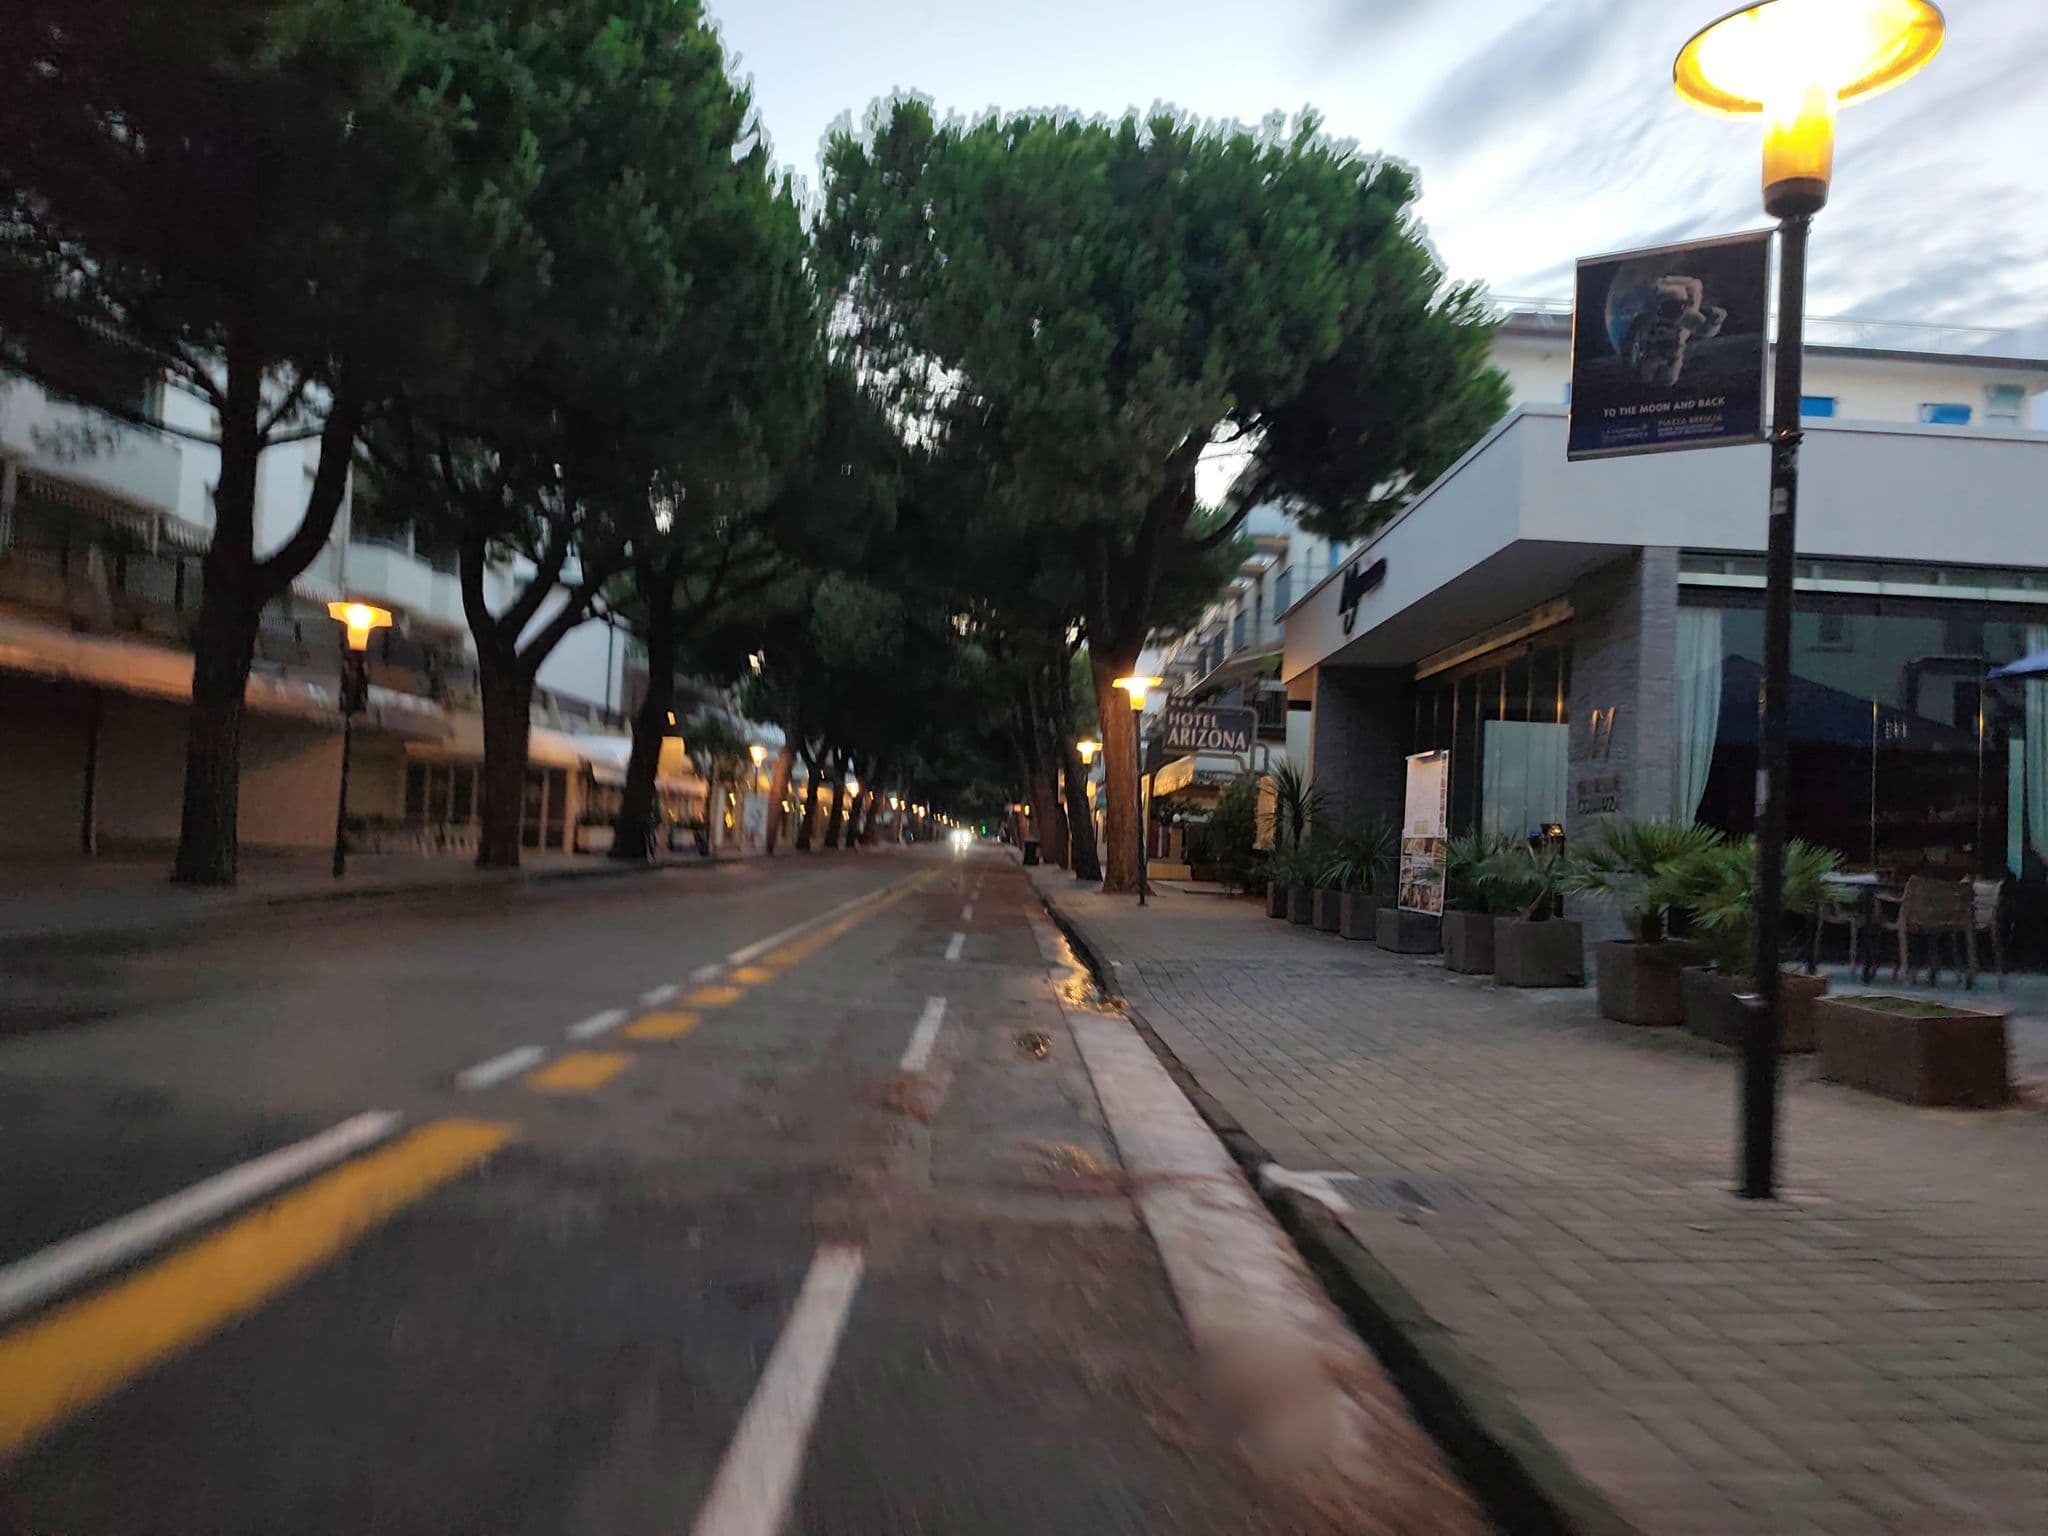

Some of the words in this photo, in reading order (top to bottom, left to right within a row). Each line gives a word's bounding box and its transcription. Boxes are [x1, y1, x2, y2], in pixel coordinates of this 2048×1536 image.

[1603, 408, 1616, 418] TO
[1619, 406, 1637, 416] THE
[1639, 402, 1671, 414] MOON
[1674, 399, 1695, 410] AND
[1698, 396, 1725, 407] BACK
[1168, 711, 1218, 728] HOTEL
[1168, 728, 1246, 749] ARIZONA
